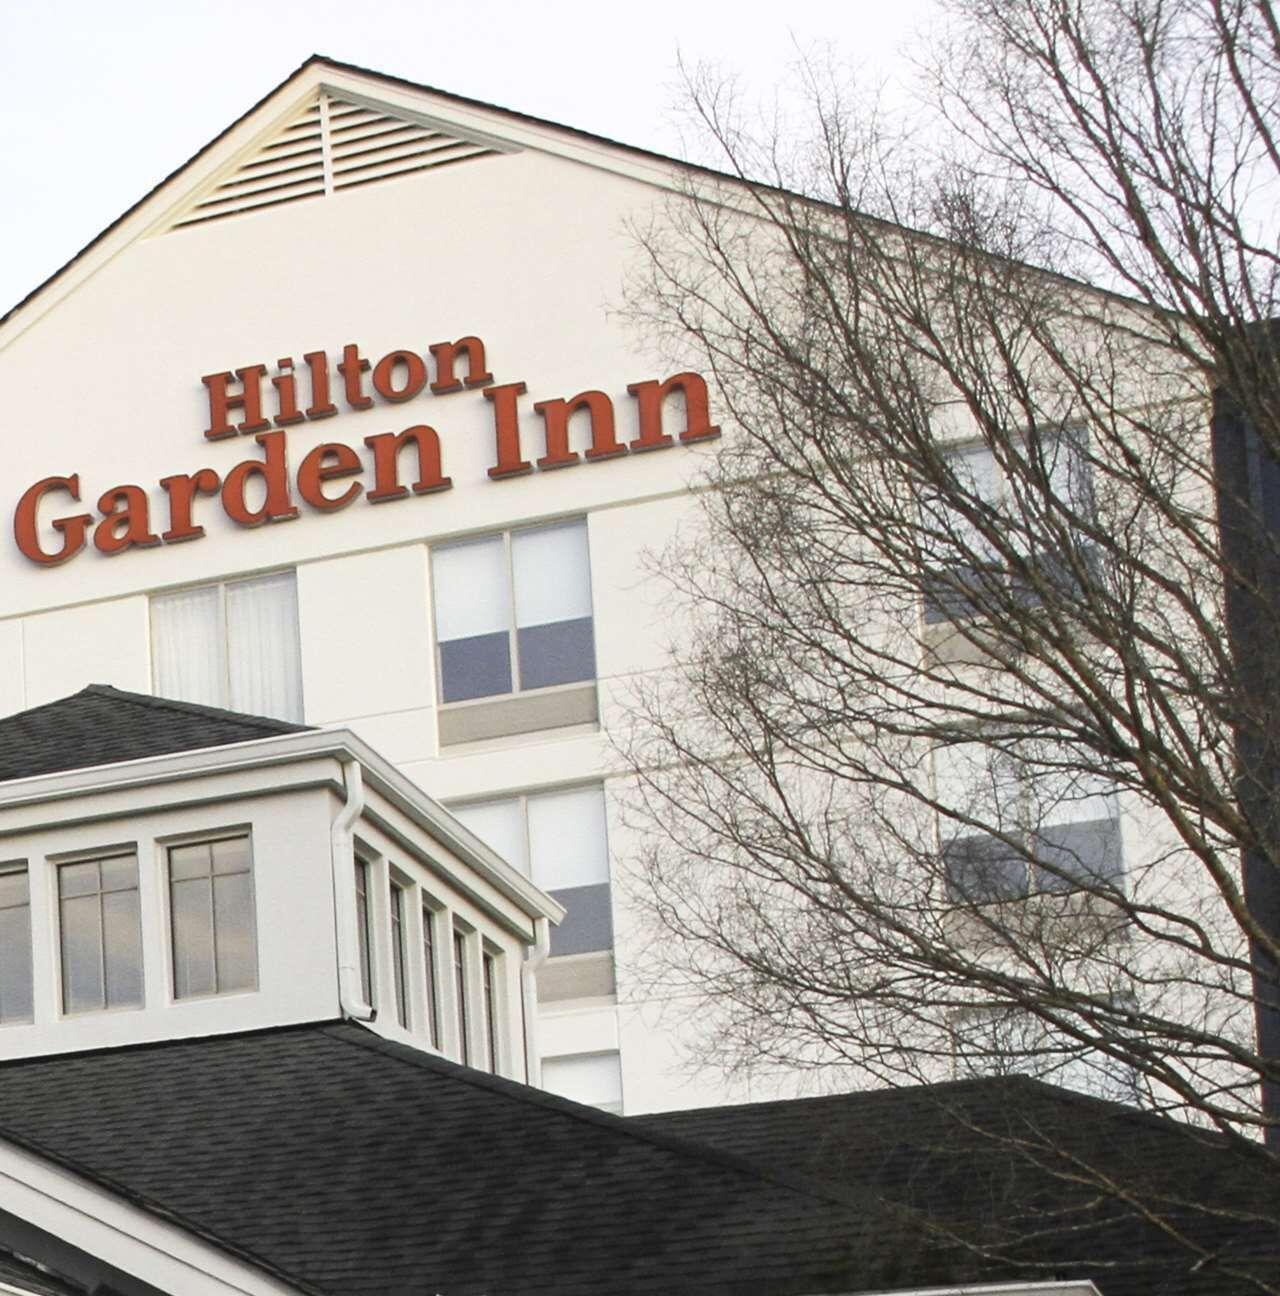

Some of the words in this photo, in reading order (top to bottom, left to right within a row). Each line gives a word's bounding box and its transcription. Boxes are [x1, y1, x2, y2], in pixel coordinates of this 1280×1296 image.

[202, 335, 492, 441] Hilton
[13, 424, 452, 567] Garden
[483, 371, 722, 481] Inn
